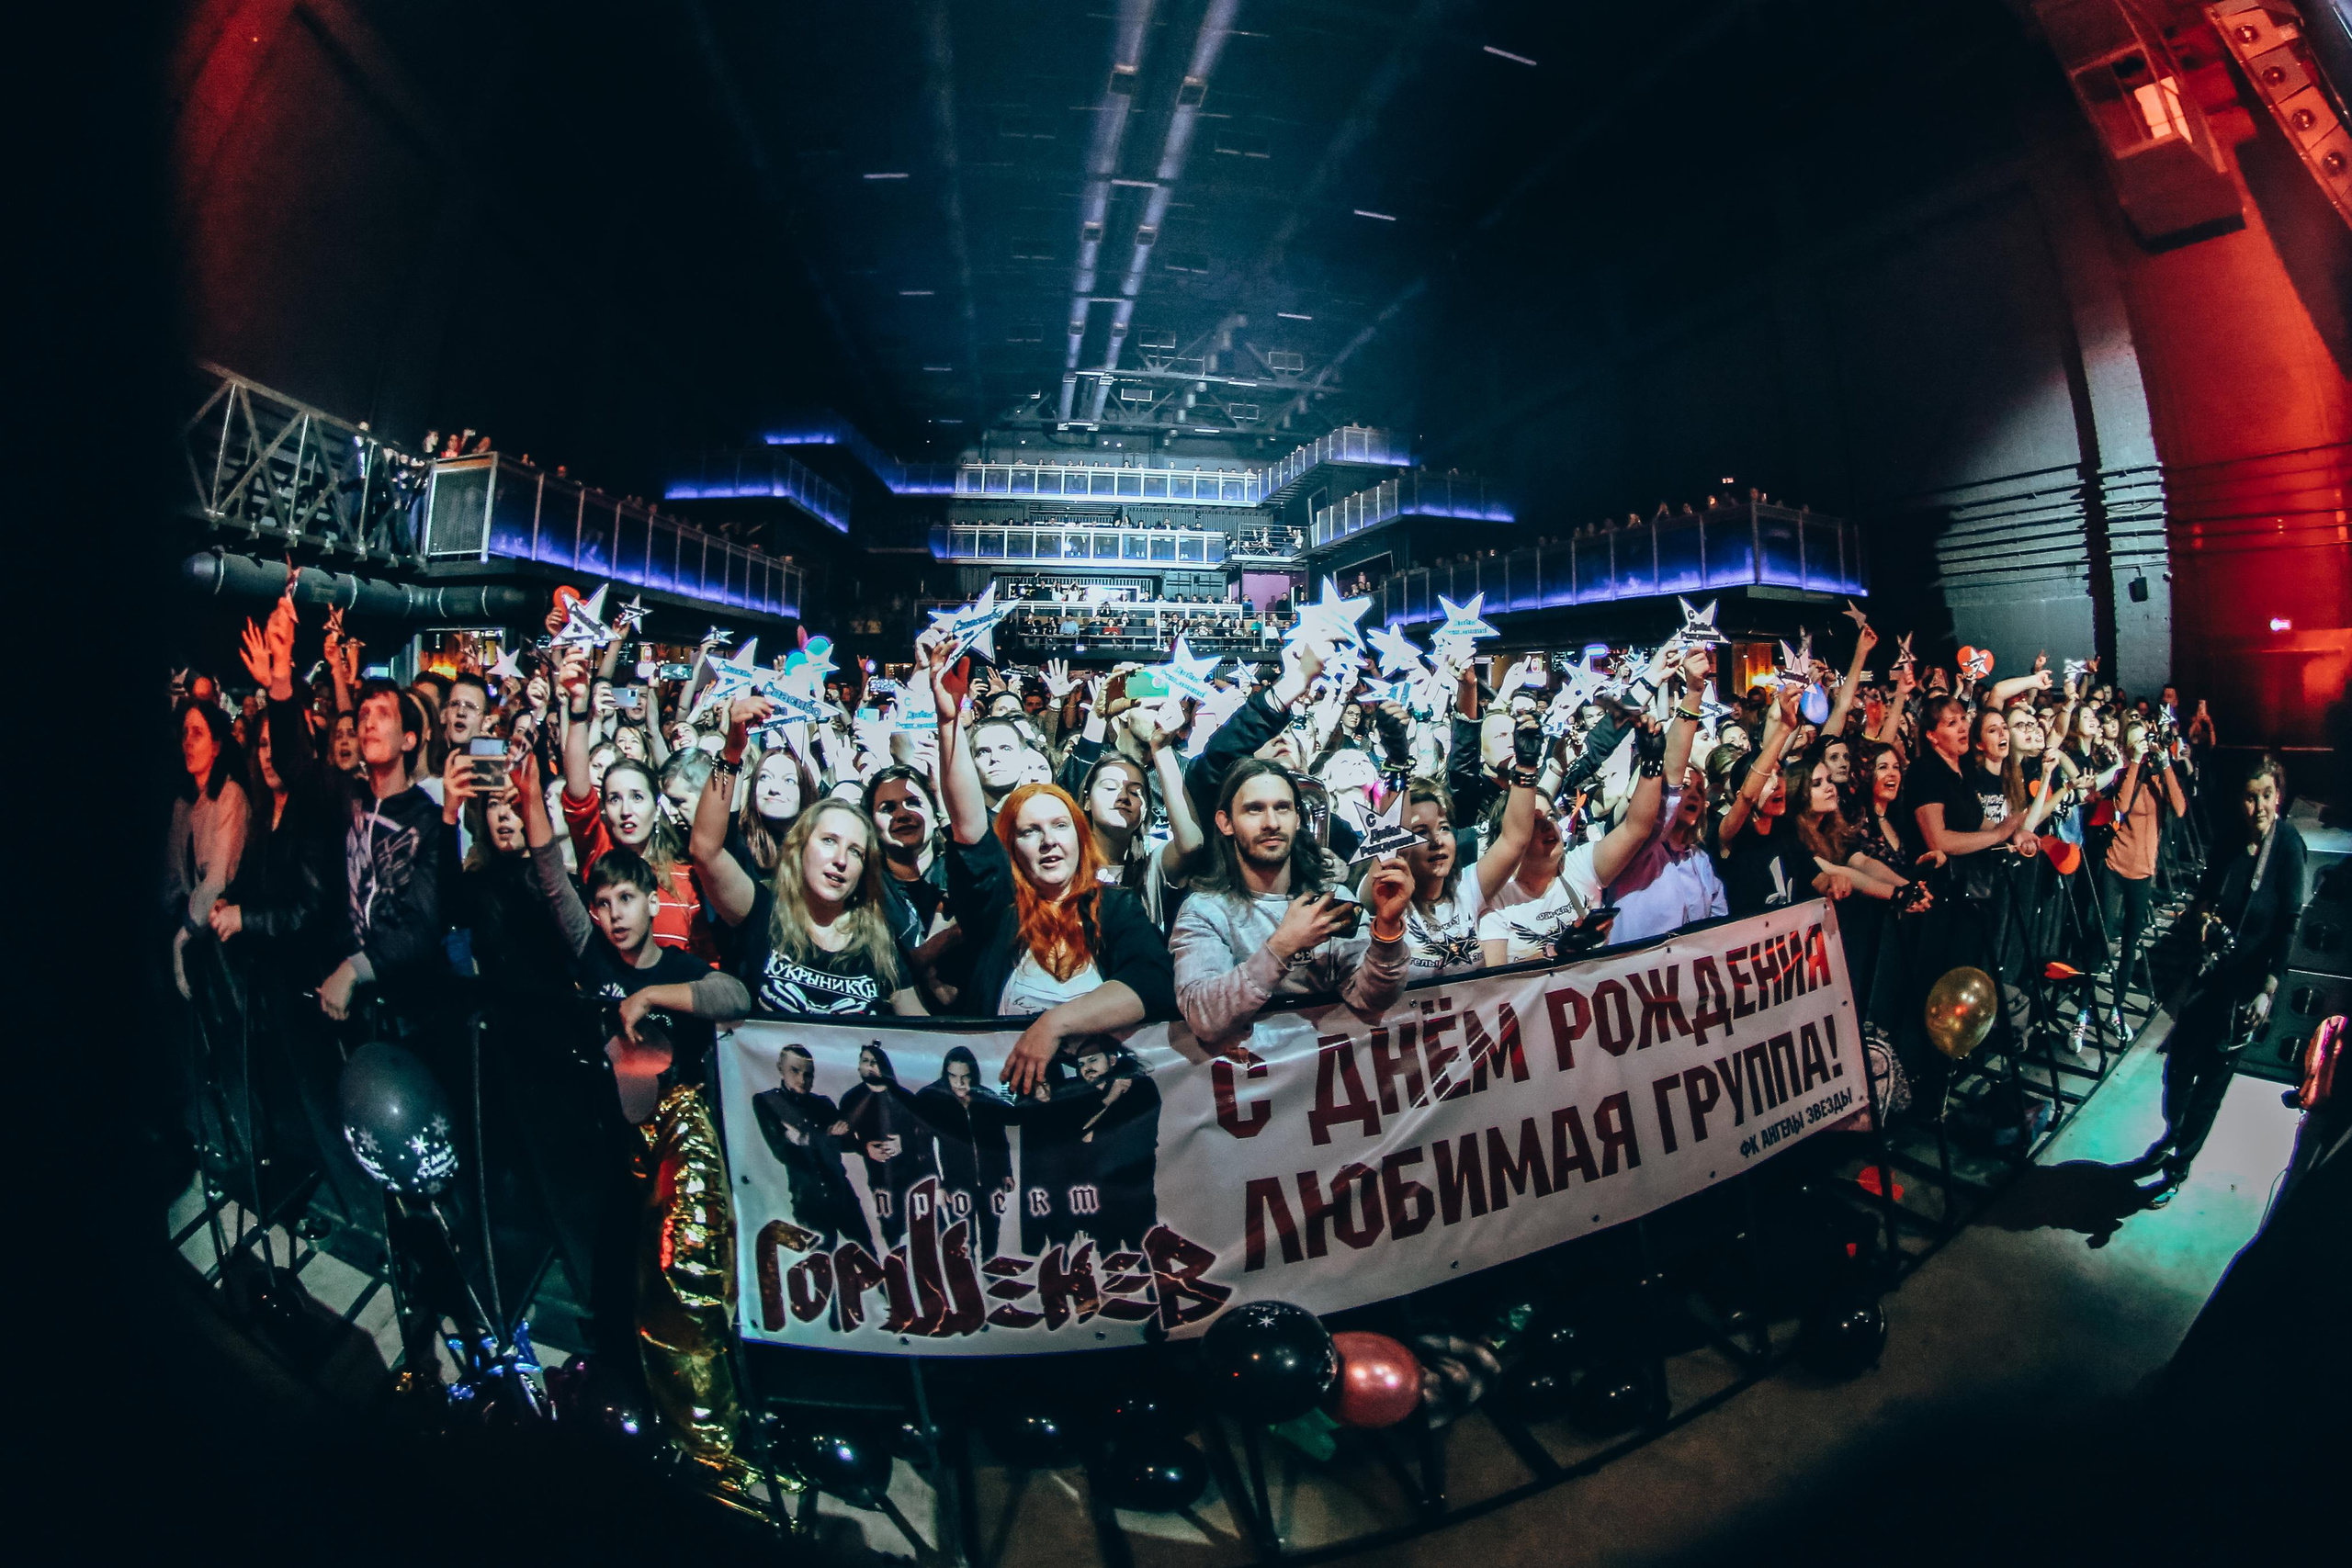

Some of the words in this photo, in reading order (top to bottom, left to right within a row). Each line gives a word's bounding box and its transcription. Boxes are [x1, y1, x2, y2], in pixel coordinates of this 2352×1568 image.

[1687, 609, 1696, 620] С
[761, 681, 821, 718] Спасибо
[1365, 813, 1377, 828] С
[1369, 824, 1402, 844] Днём
[1211, 1047, 1272, 1140] С
[1308, 997, 1530, 1146] ДНЁМ
[1544, 921, 1832, 1072] РОЖДЕНИЯ
[1739, 1134, 1760, 1159] ФК
[1760, 1111, 1805, 1149] АНГЕЛЫ
[1805, 1087, 1853, 1124] ЗВЕЗДЫ
[1243, 1089, 1642, 1273] ЛЮБИМАЯ
[1651, 1015, 1845, 1155] ГРУППА!
